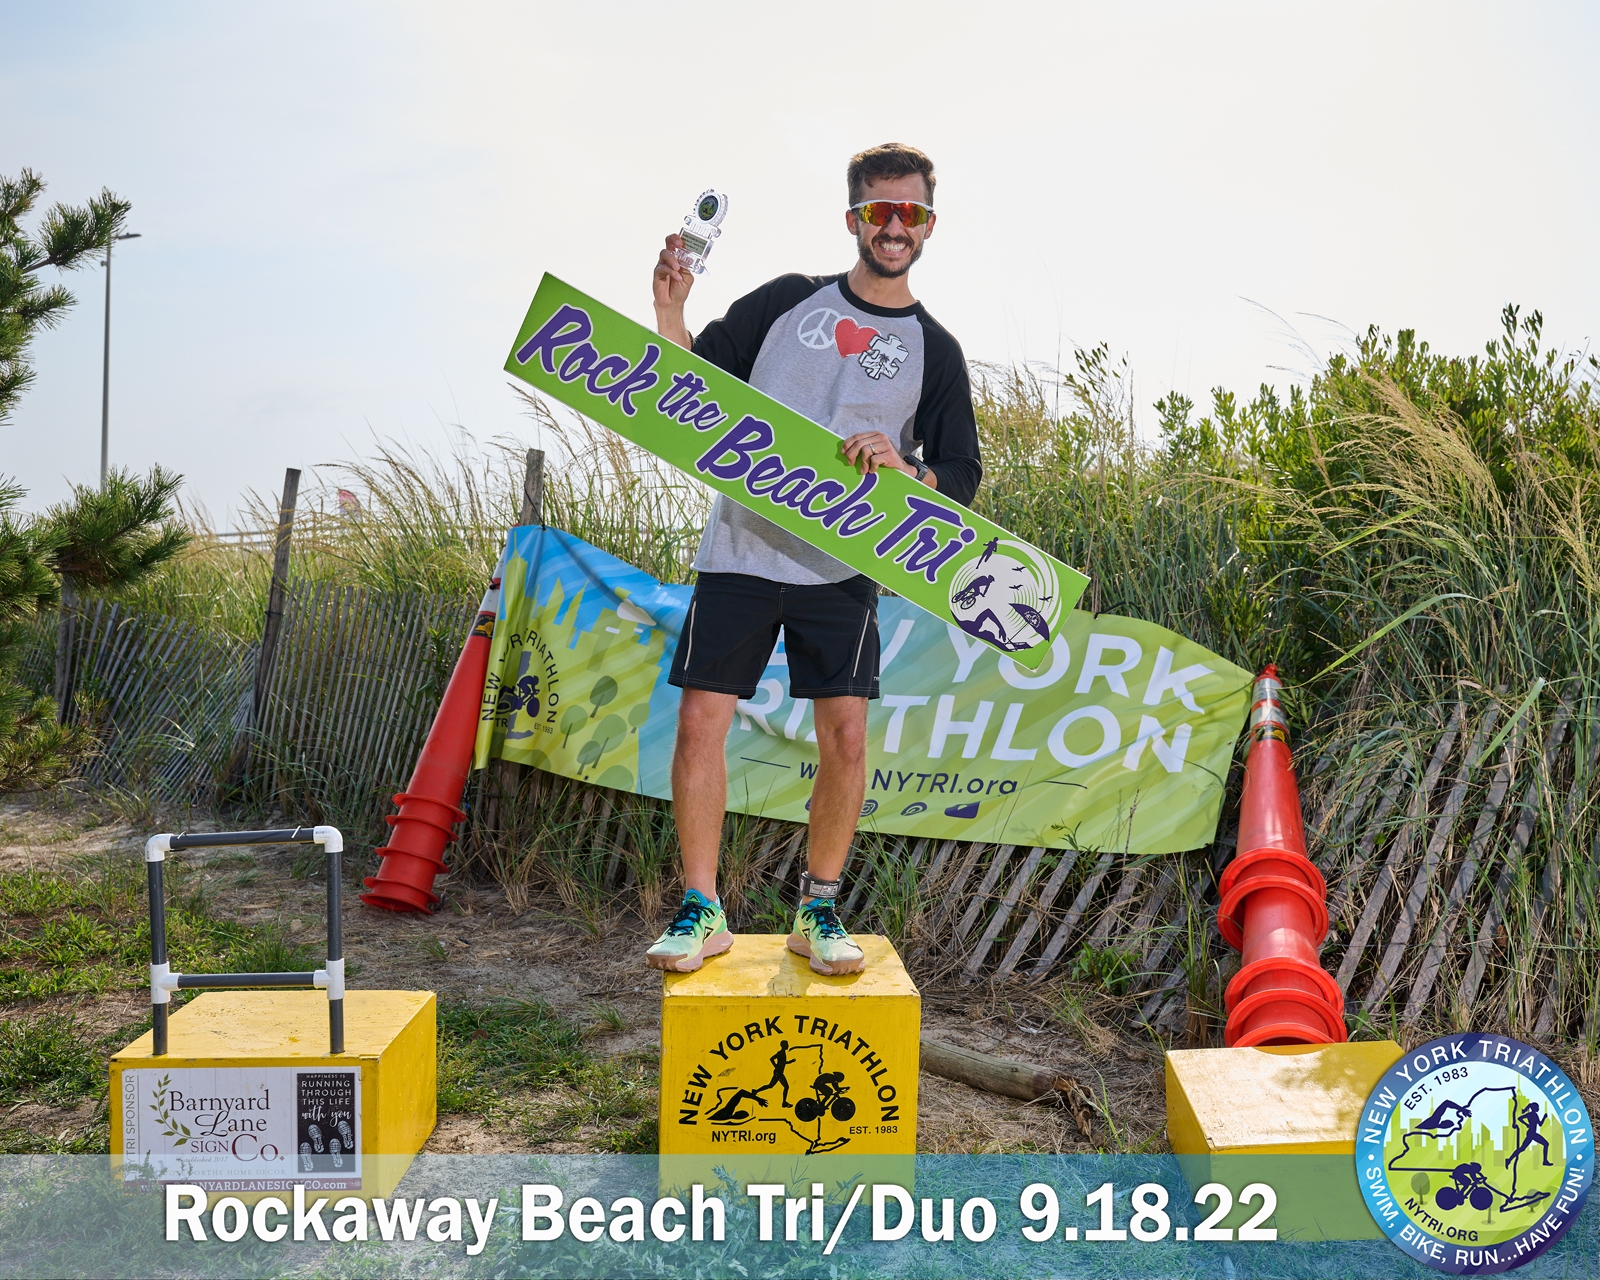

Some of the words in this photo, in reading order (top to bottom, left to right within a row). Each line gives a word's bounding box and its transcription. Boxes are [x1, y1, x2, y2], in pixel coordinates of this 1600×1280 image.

[515, 303, 661, 417] Rock
[657, 371, 728, 432] the
[695, 414, 885, 539] Beach
[874, 495, 976, 583] Tri
[481, 672, 501, 721] NEW
[525, 628, 560, 723] RIATHLON
[737, 677, 1193, 773] RITHLON
[678, 1064, 713, 1125] NEW
[709, 1015, 783, 1061] YORK
[794, 1014, 900, 1121] TRIATHLON
[301, 1080, 350, 1088] RUNNING
[301, 1088, 352, 1097] THROUGH
[125, 1075, 136, 1135] SPONSOR
[169, 1089, 271, 1114] Barnyard
[302, 1098, 325, 1106] THIS
[329, 1098, 350, 1106] LIFE
[194, 1110, 268, 1137] Lane
[301, 1104, 327, 1122] with
[330, 1110, 352, 1127] you
[711, 1130, 777, 1144] NYTRI.org
[849, 1126, 872, 1134] EST.
[875, 1125, 898, 1134] 1983
[126, 1138, 136, 1174] YTRI
[191, 1140, 229, 1153] SIGN
[231, 1133, 285, 1162] Co.
[256, 1168, 286, 1176] DECOR
